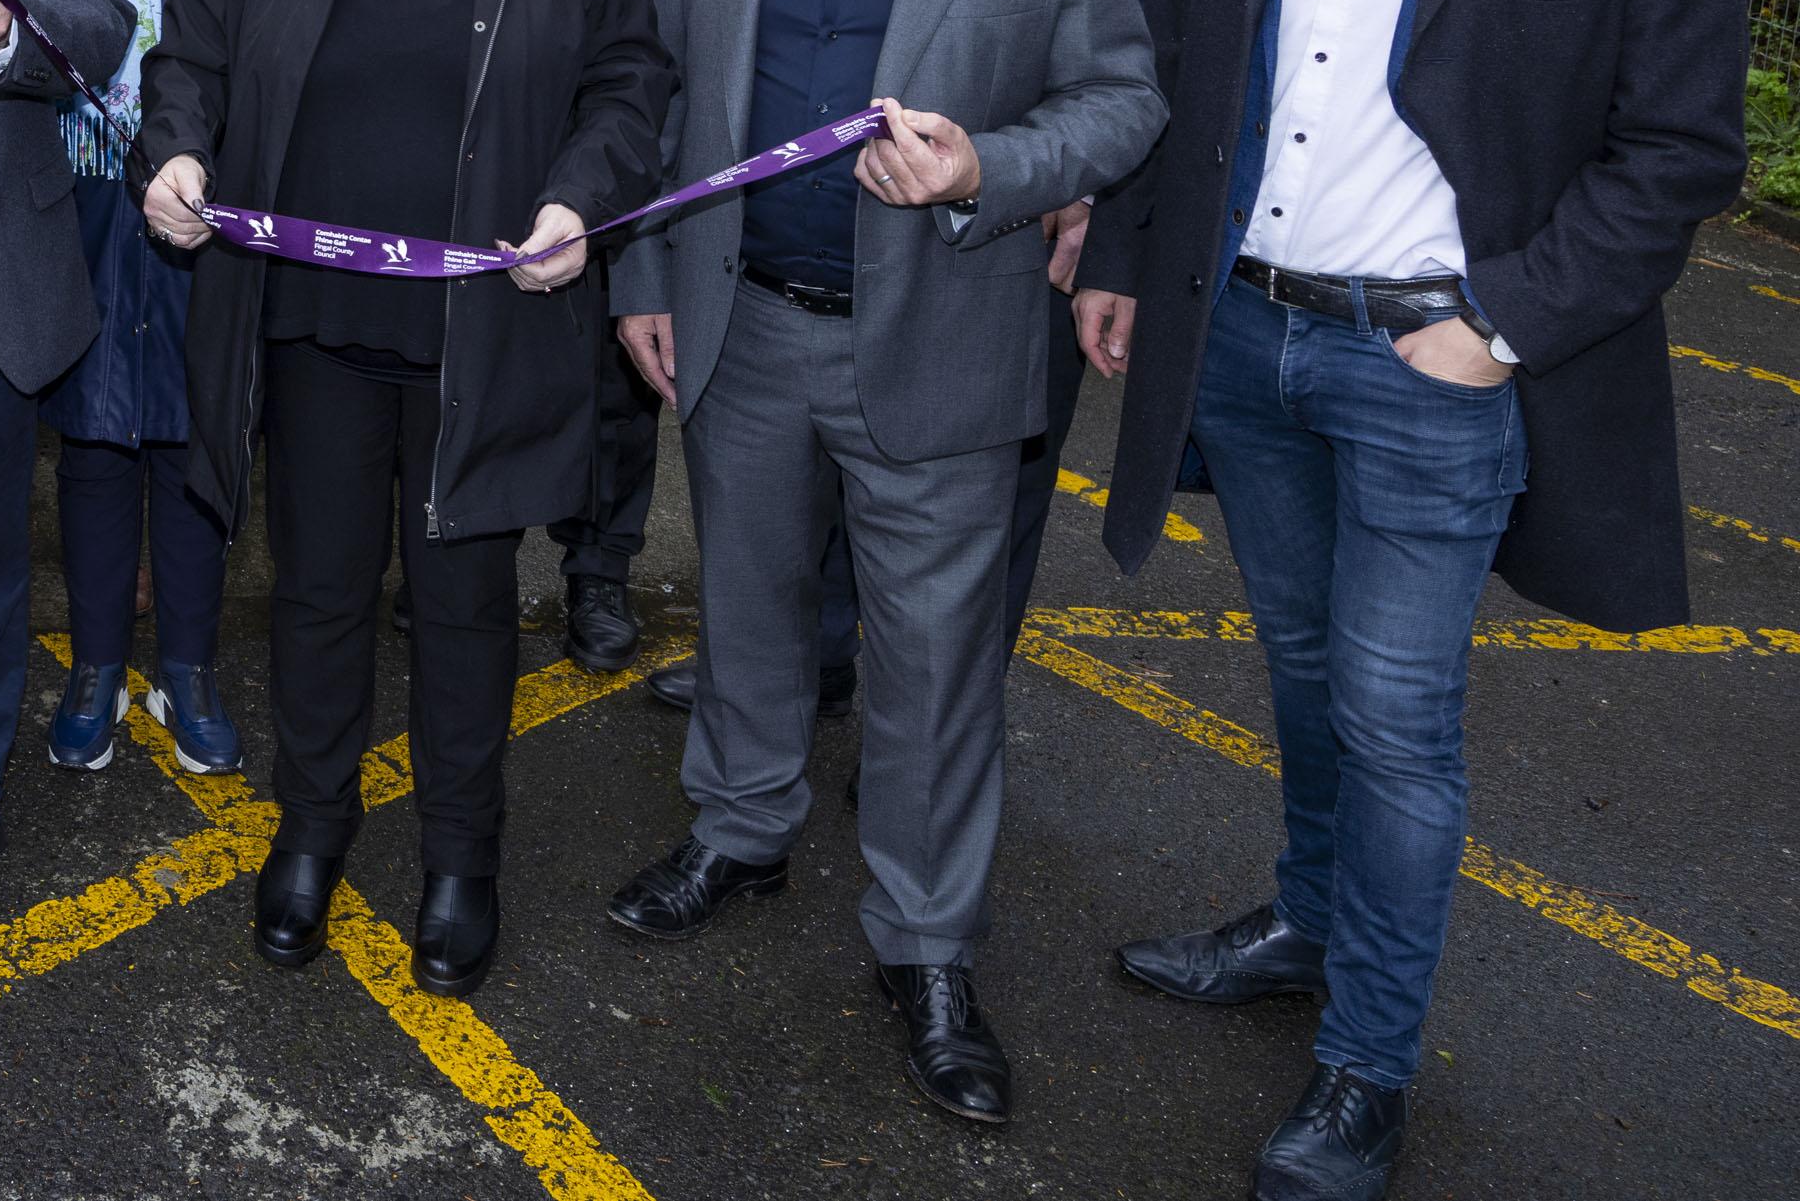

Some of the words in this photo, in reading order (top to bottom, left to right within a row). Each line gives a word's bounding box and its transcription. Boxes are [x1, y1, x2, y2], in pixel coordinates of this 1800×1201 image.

[315, 229, 348, 240] Comhairle
[349, 235, 372, 244] Contae
[315, 236, 333, 245] Fhine
[333, 239, 347, 247] Gall
[313, 250, 336, 259] Council
[314, 243, 332, 252] Fingal
[332, 246, 355, 257] County
[444, 249, 478, 259] Comhairle
[478, 254, 502, 262] Contae
